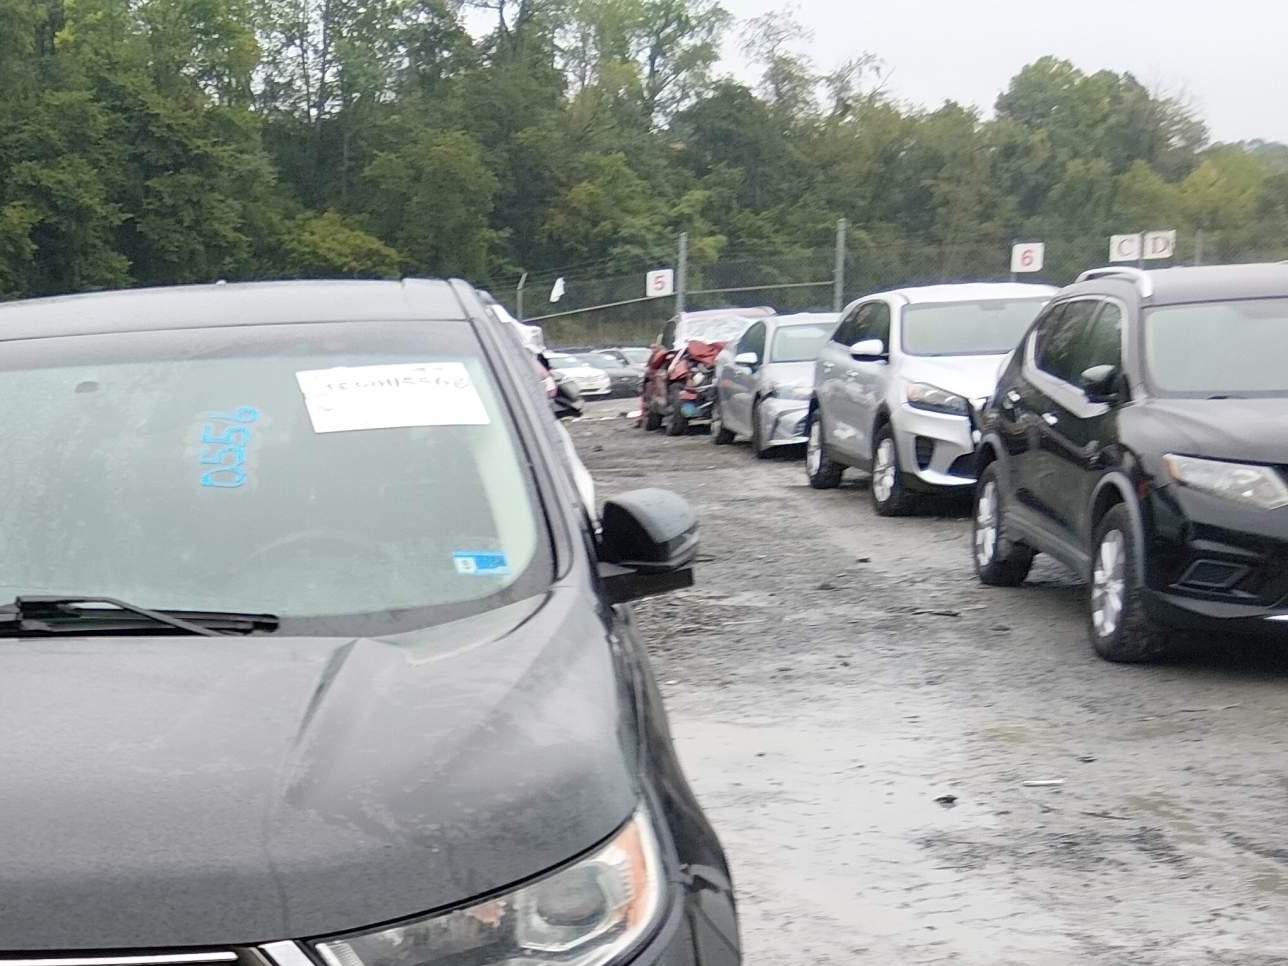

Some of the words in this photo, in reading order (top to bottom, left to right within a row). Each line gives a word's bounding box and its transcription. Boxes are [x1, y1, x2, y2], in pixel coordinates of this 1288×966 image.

[1117, 238, 1135, 257] C
[1151, 236, 1170, 254] D
[1020, 248, 1034, 267] 6
[654, 274, 665, 291] 5
